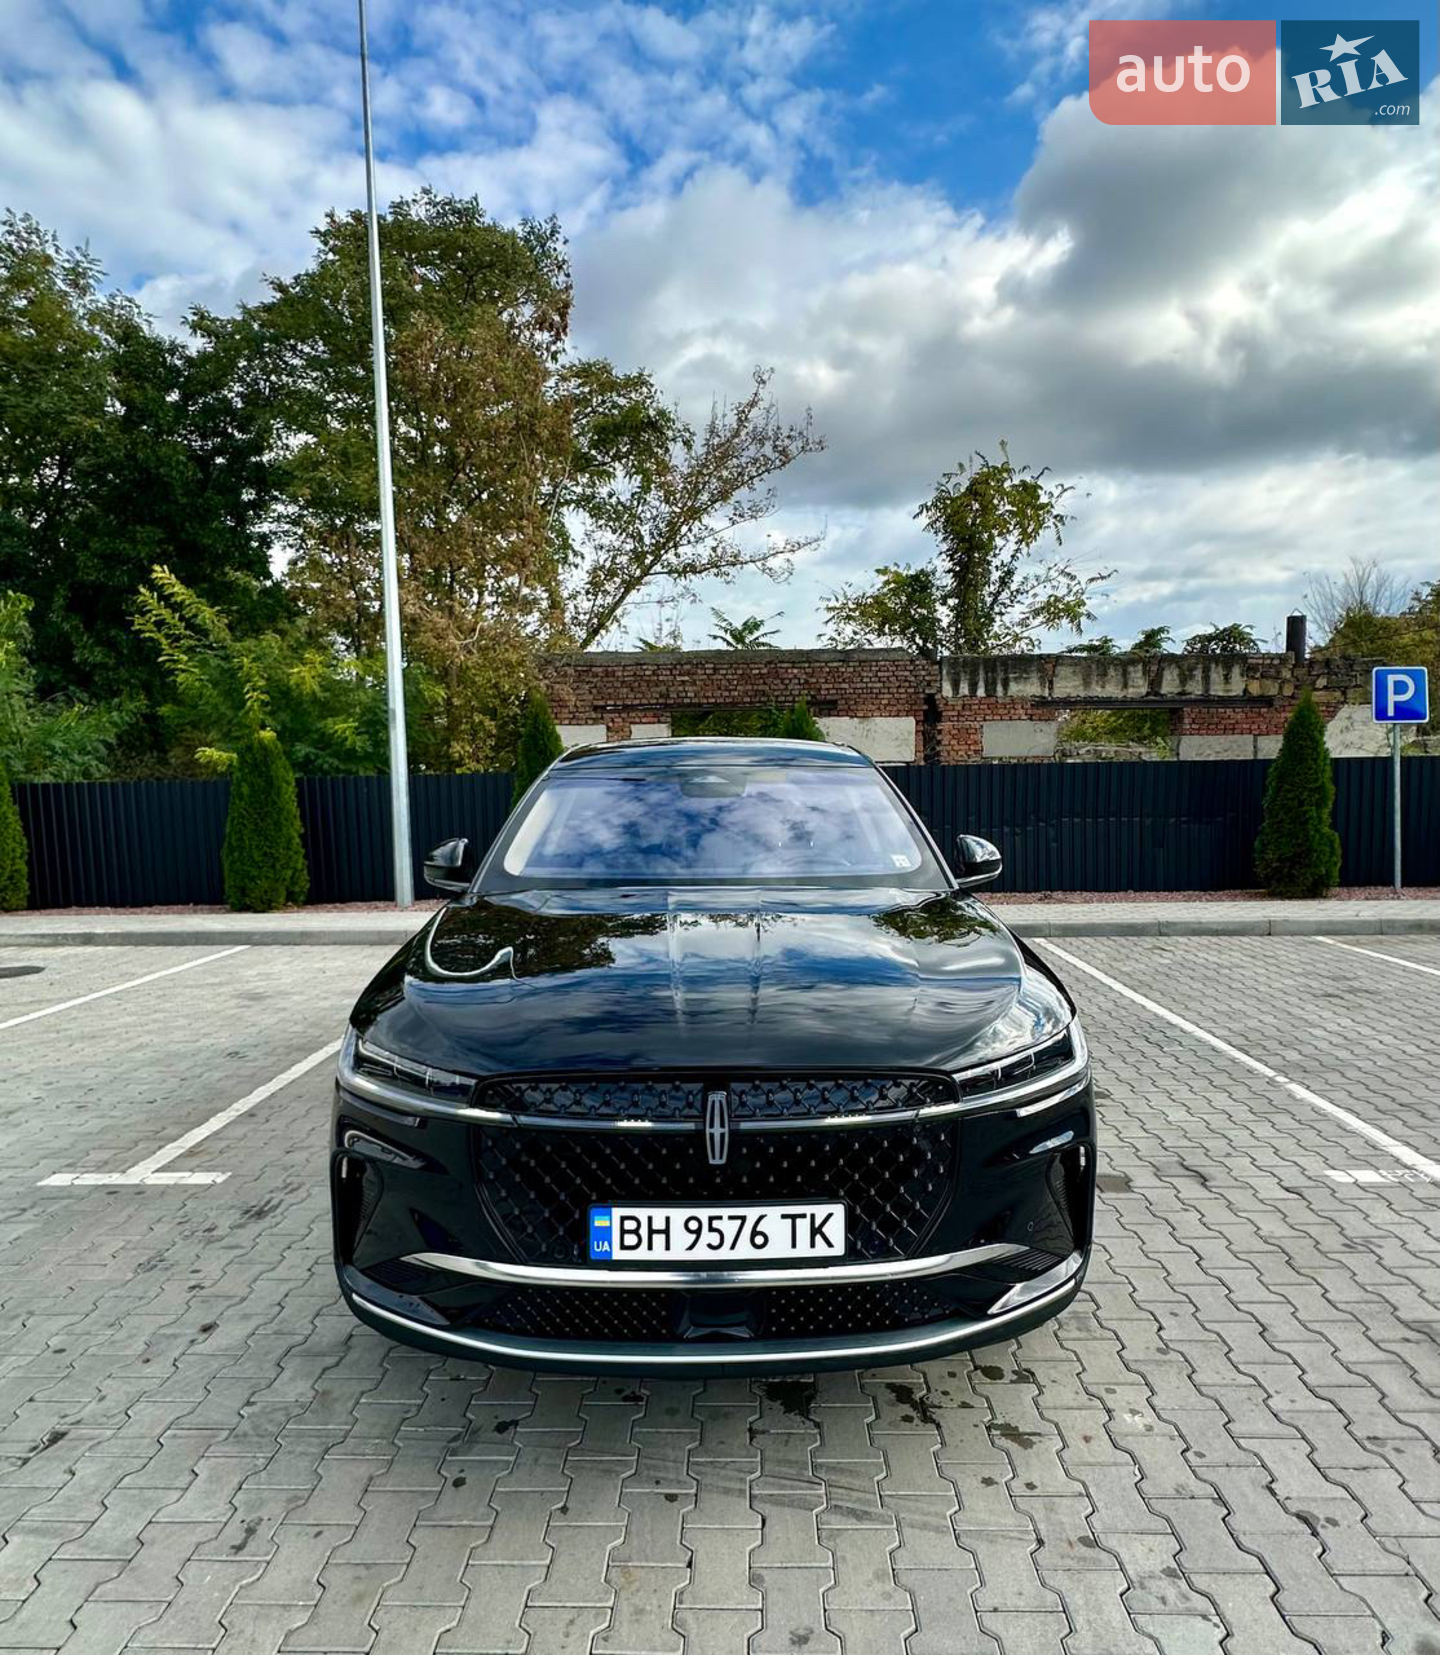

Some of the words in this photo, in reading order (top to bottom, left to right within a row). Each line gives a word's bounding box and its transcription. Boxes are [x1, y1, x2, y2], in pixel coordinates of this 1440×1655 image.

[1387, 674, 1415, 717] P
[594, 1241, 611, 1252] UA
[619, 1215, 671, 1251] BH
[683, 1214, 769, 1251] 9576
[780, 1212, 835, 1249] TK
